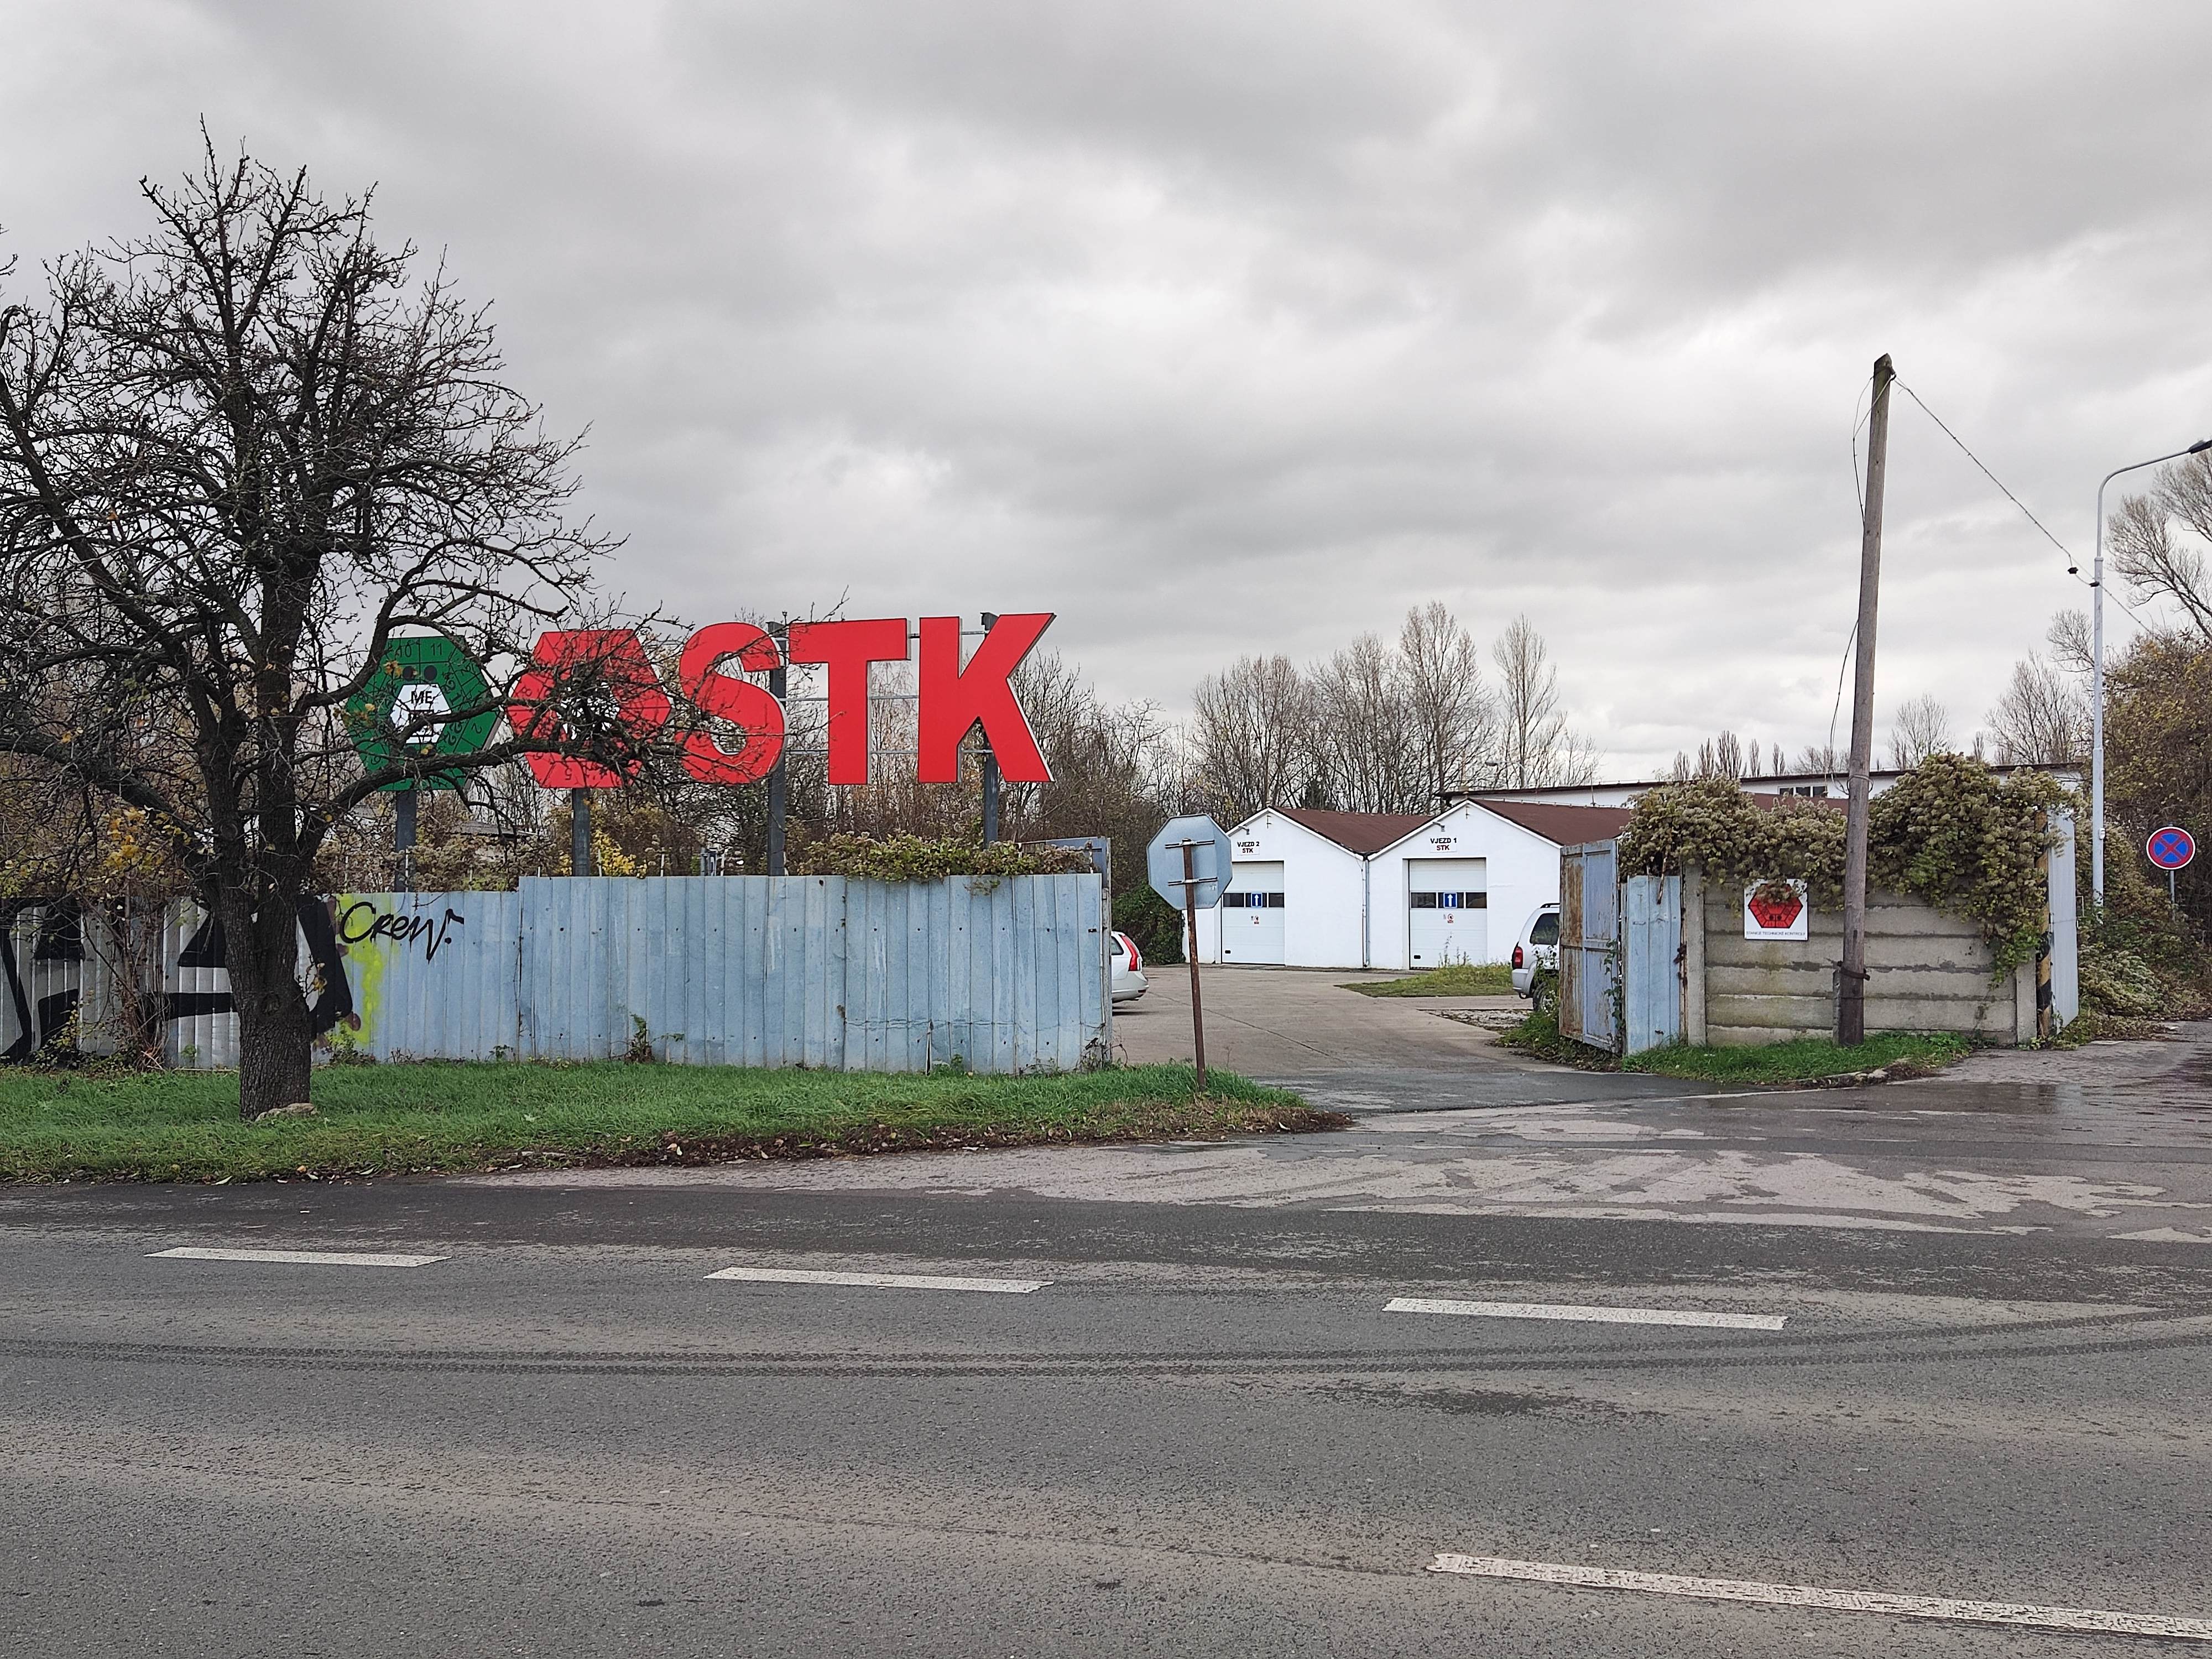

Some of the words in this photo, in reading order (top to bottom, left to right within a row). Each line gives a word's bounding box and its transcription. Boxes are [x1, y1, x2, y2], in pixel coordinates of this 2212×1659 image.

[431, 643, 442, 655] 11
[411, 691, 432, 704] ME
[675, 612, 1055, 785] STK
